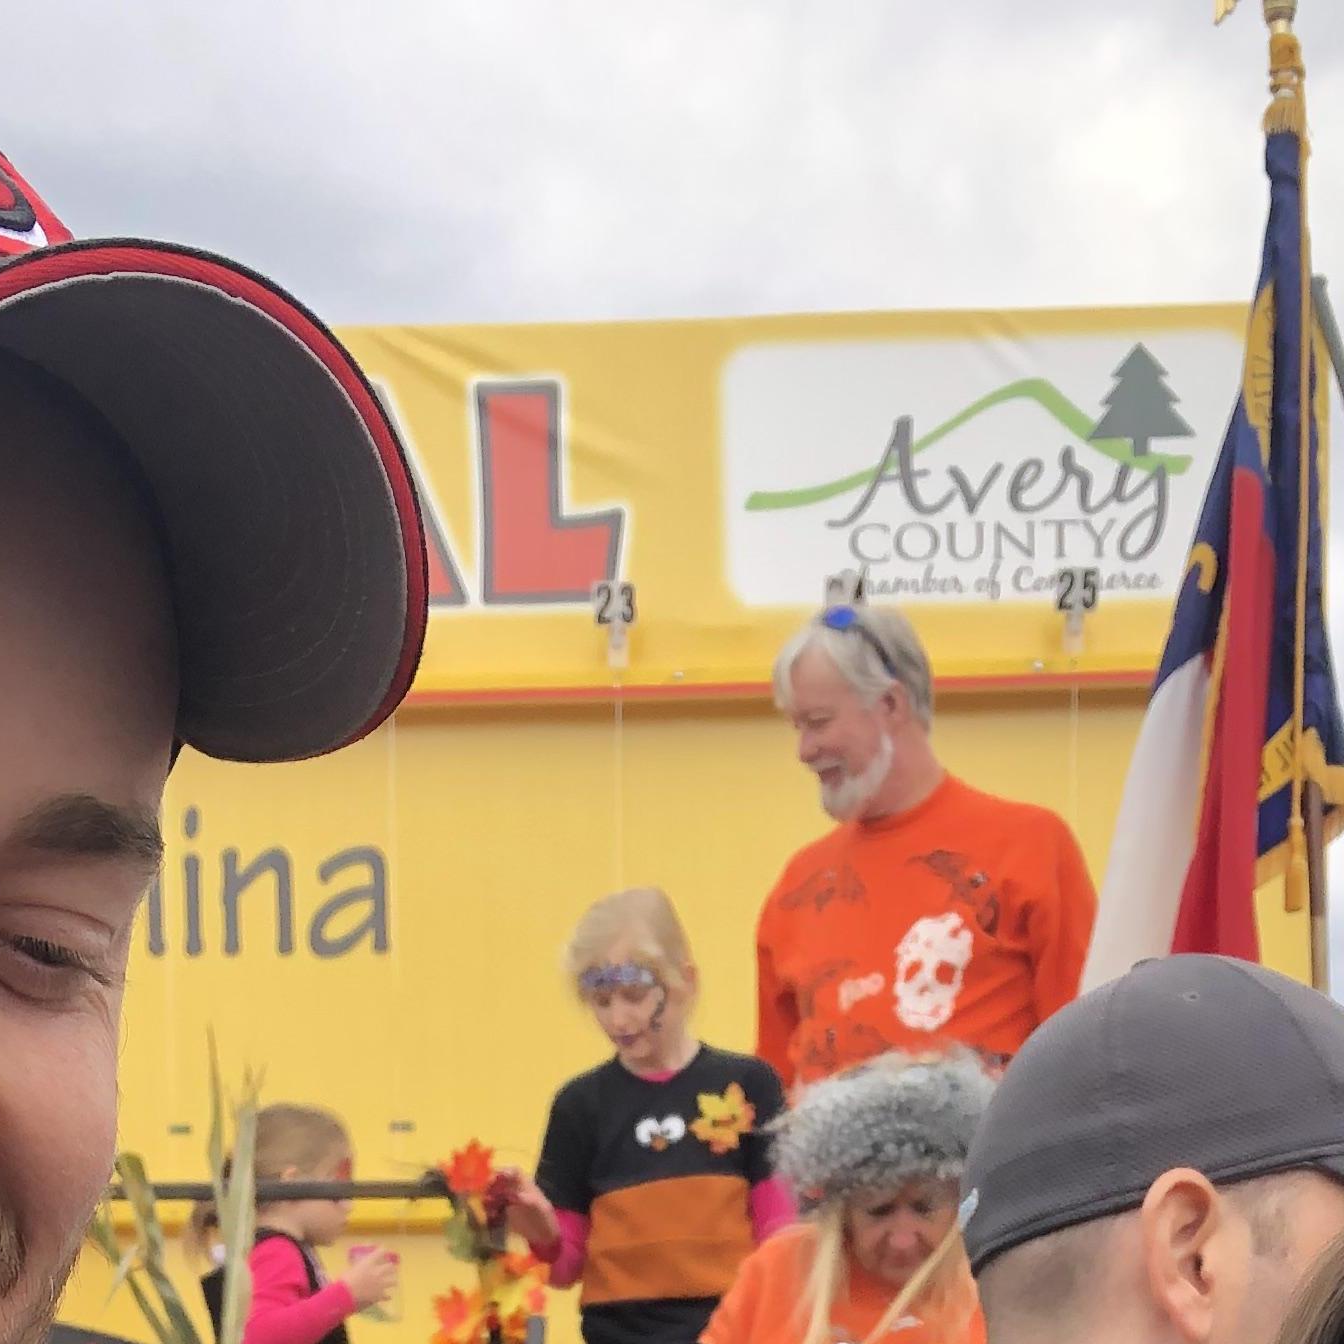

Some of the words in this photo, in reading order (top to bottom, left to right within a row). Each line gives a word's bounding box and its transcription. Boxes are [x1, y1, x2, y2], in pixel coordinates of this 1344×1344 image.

[825, 415, 1170, 562] Avery
[848, 518, 1118, 564] COUNTY
[974, 558, 1002, 600] of
[1012, 565, 1160, 596] Coerce
[1058, 570, 1097, 611] 25
[597, 583, 635, 624] 23
